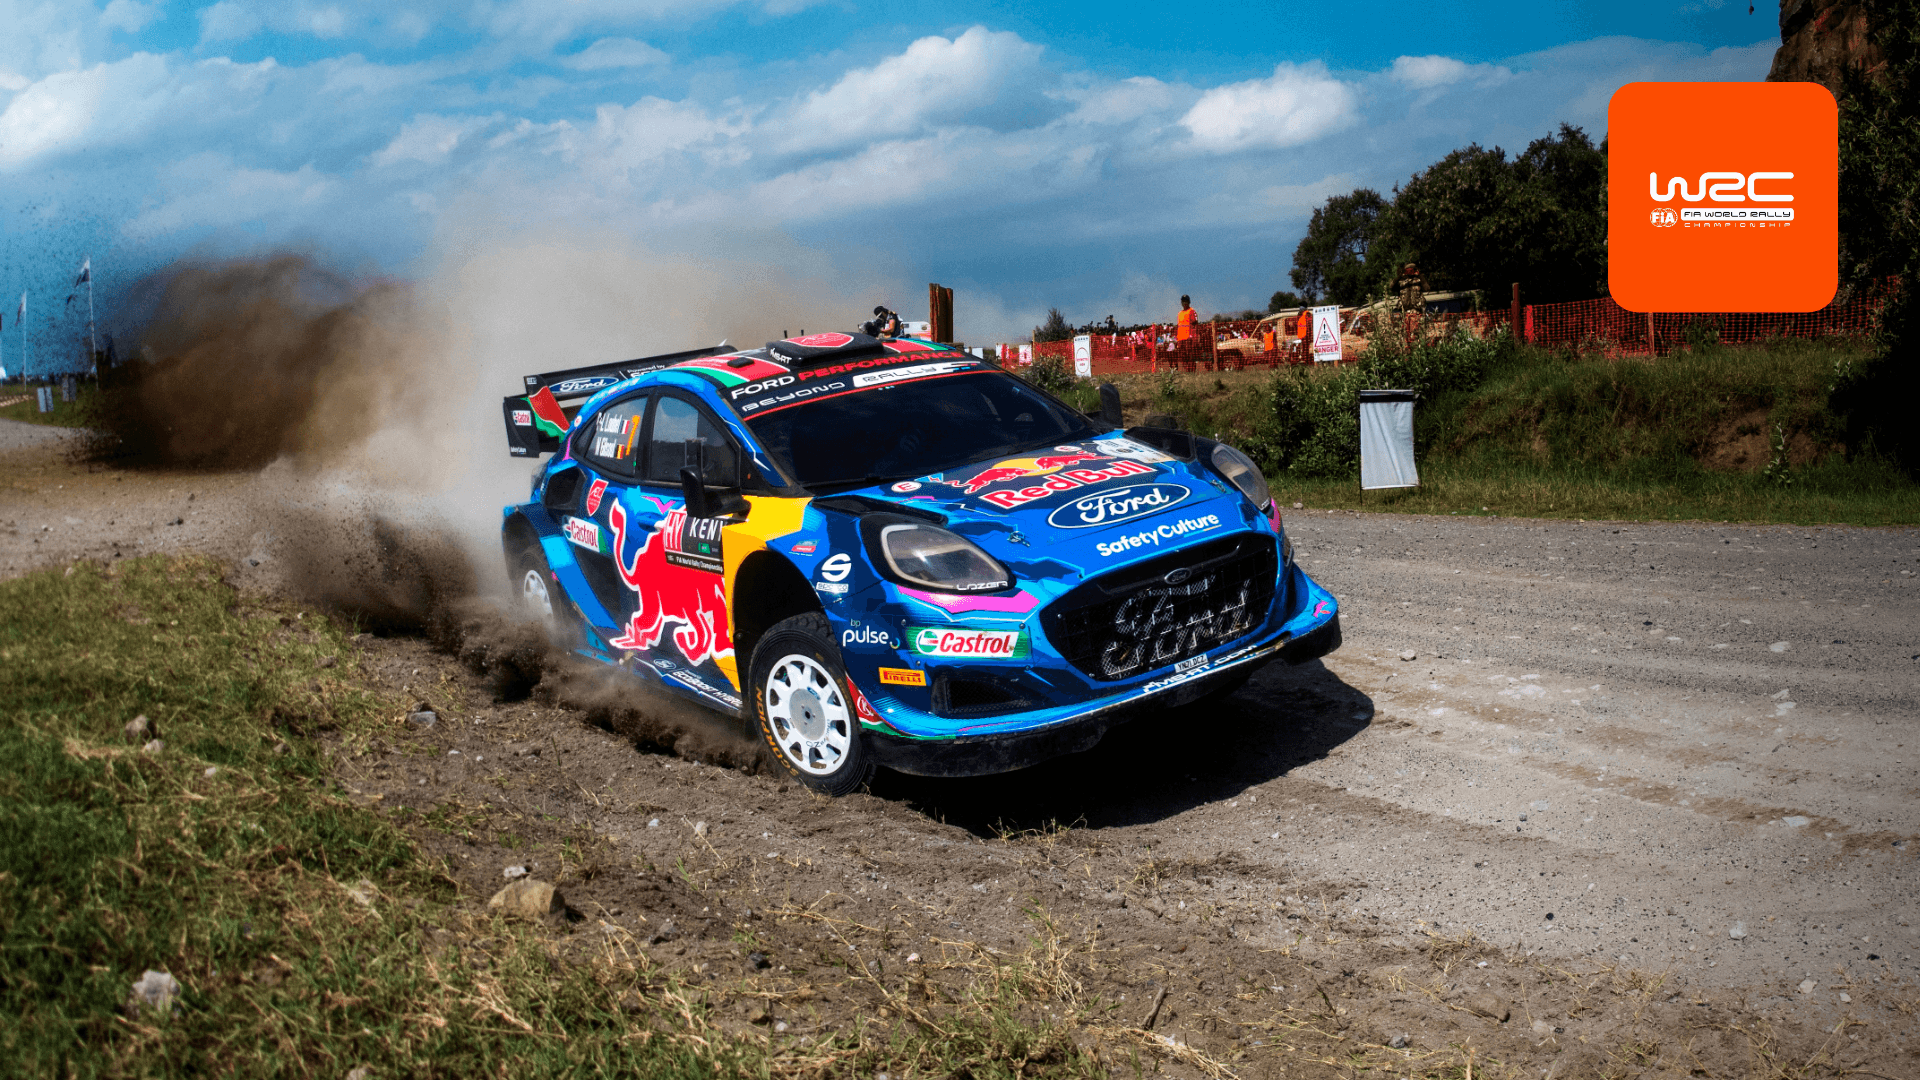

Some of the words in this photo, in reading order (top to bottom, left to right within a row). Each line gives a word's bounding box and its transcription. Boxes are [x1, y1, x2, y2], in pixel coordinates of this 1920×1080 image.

[560, 379, 606, 392] Ford
[731, 376, 795, 399] FORD
[798, 351, 965, 381] PERFORMANCE
[741, 382, 845, 412] BEYOND
[862, 365, 937, 383] RALLY
[978, 474, 1083, 509] Red
[1064, 460, 1157, 485] Bull
[1076, 488, 1170, 523] Ford
[571, 519, 598, 548] Castrol
[664, 511, 687, 549] HY
[1096, 513, 1220, 557] SafetyCulture
[956, 580, 1008, 590] LAZER
[842, 625, 889, 648] pulse
[850, 618, 861, 628] bp
[940, 632, 1011, 653] Castrol
